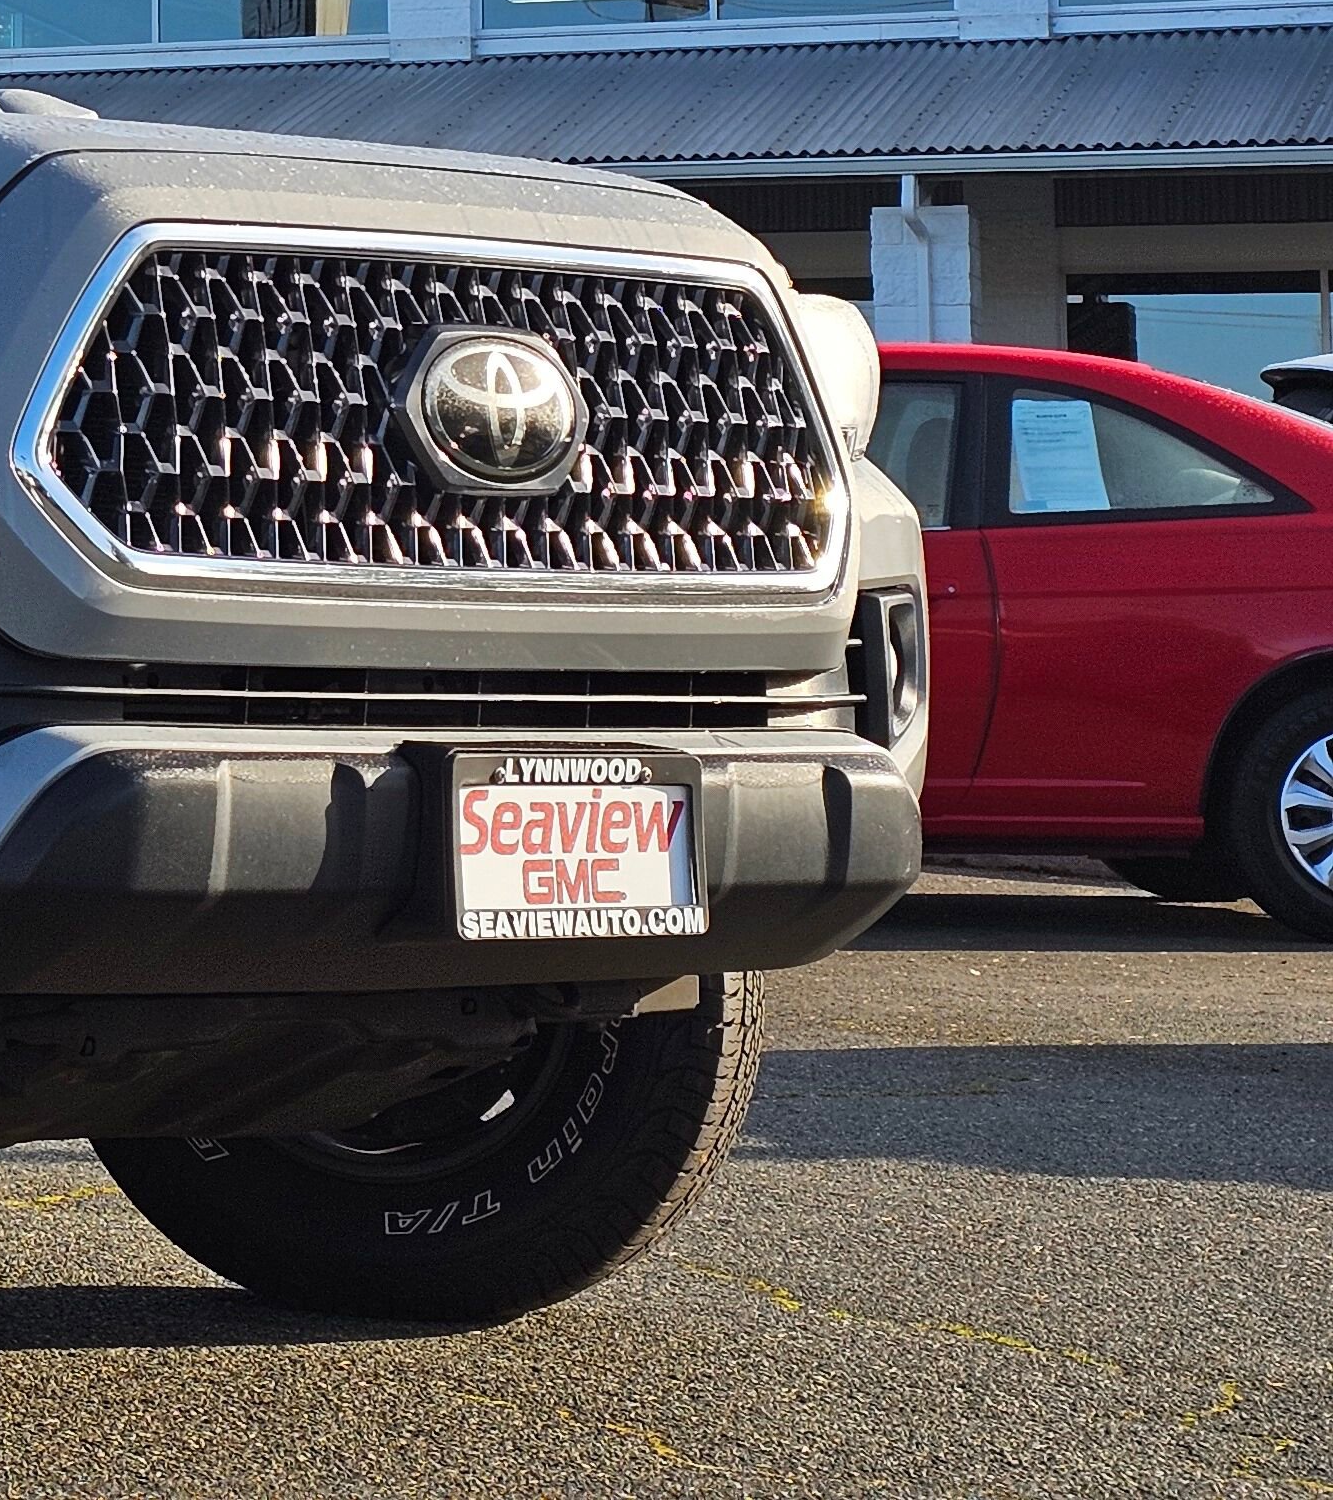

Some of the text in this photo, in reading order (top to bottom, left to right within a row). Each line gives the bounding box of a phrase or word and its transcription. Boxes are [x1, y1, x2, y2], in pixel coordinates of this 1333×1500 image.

[504, 757, 642, 783] LYNNWOOD
[459, 788, 684, 855] Seaview
[523, 859, 624, 904] GMC
[460, 907, 706, 939] SEAVIEWAUTO.COM
[384, 1188, 502, 1236] T/A
